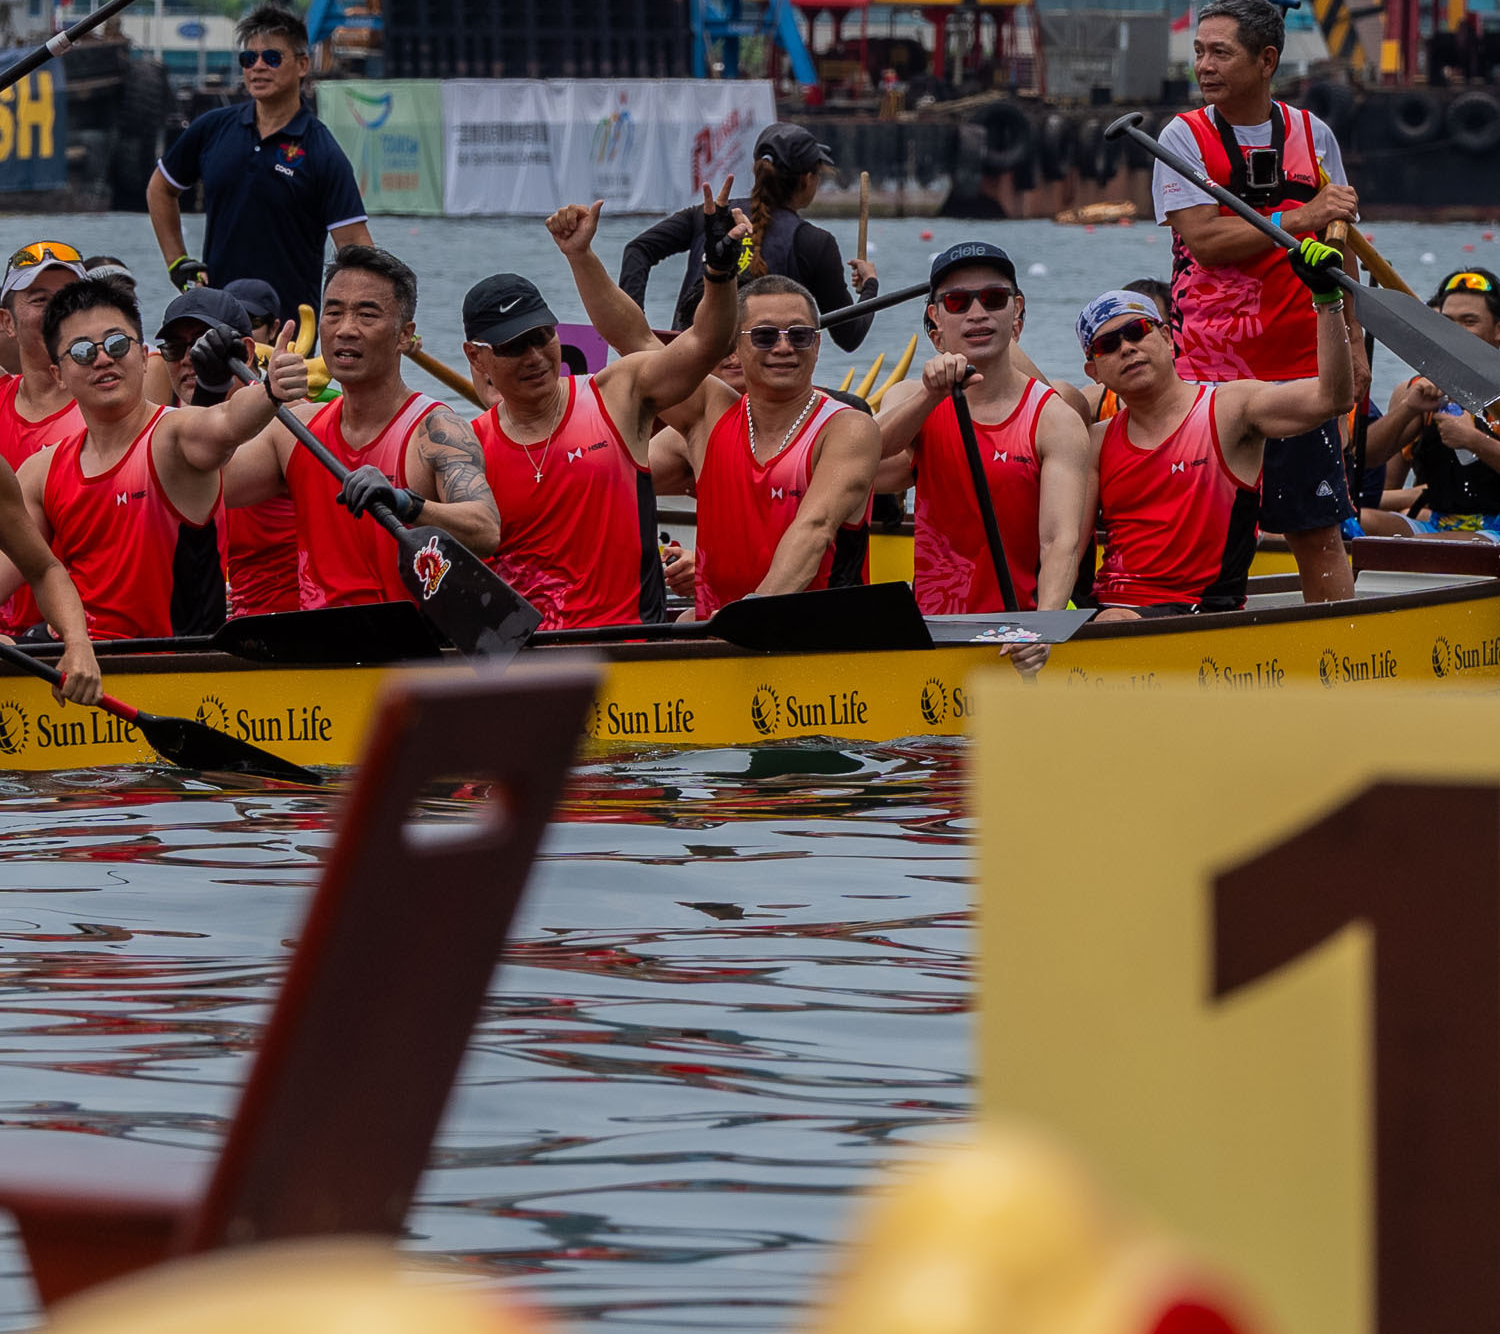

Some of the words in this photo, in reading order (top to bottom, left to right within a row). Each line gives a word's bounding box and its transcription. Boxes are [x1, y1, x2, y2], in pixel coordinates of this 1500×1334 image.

[949, 243, 986, 261] ciele
[588, 439, 608, 452] HSBC
[1342, 656, 1369, 684] Sun
[1371, 650, 1398, 681] Life
[1453, 643, 1479, 671] Sun
[1223, 666, 1253, 692] Sun
[1256, 658, 1286, 690] Life
[607, 701, 650, 735] Sun
[653, 699, 695, 735] Life
[786, 695, 825, 729] Sun
[829, 691, 869, 726] Life
[952, 688, 978, 718] Su
[36, 715, 87, 748] Sun
[91, 711, 138, 746] Life
[235, 708, 284, 742] Sun
[288, 704, 332, 742] Life
